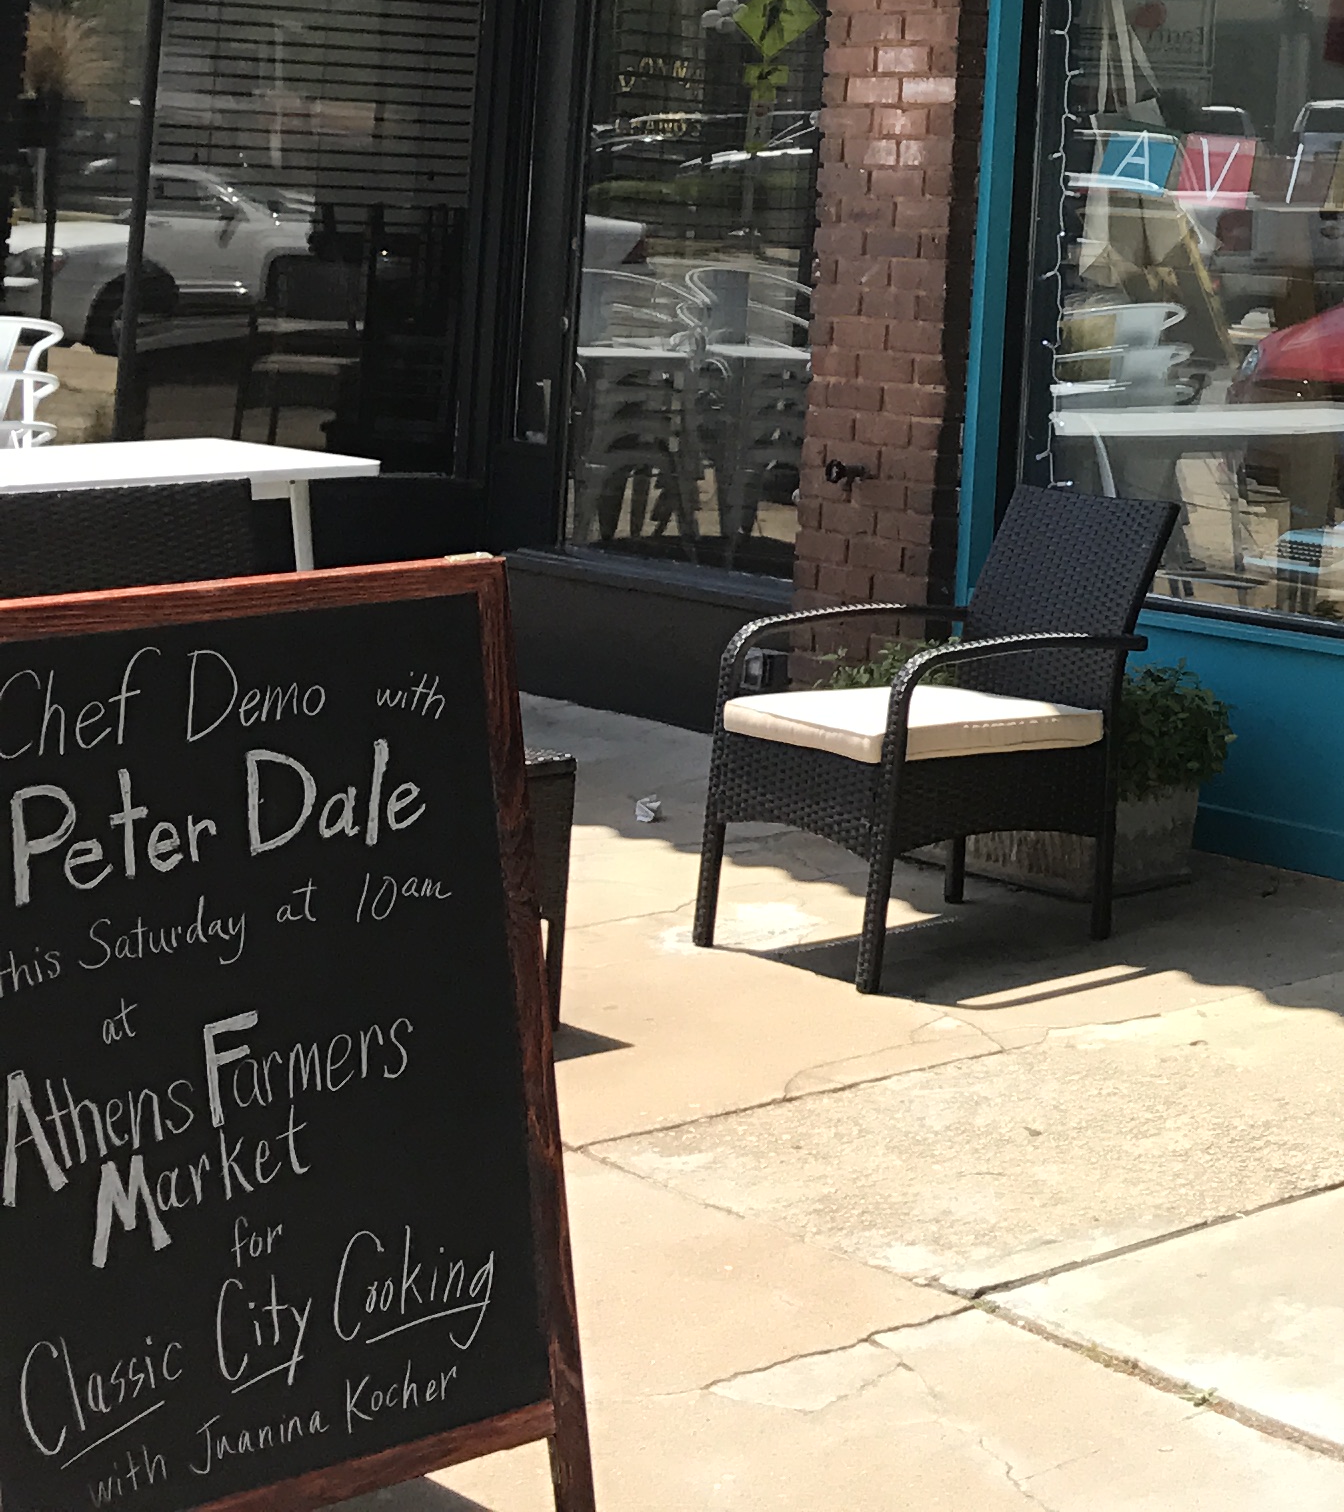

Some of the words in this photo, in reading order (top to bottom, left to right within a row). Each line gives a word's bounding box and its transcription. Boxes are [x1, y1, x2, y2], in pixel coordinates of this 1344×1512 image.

[0, 646, 162, 759] Chef
[187, 649, 327, 745] Demo
[376, 671, 447, 720] with
[10, 768, 218, 908] Peter
[245, 738, 428, 858] Dale
[78, 894, 247, 969] Saturday
[275, 884, 318, 924] at
[355, 872, 453, 922] 10am
[102, 997, 138, 1045] at
[2, 1067, 194, 1208] Athens
[204, 1009, 415, 1130] Farmers
[91, 1103, 314, 1269] Market
[230, 1216, 285, 1269] for
[20, 1333, 183, 1457] Classic
[216, 1273, 314, 1385] City
[334, 1224, 497, 1350] Cooking
[88, 1445, 168, 1509] with
[345, 1359, 458, 1434] Kocher
